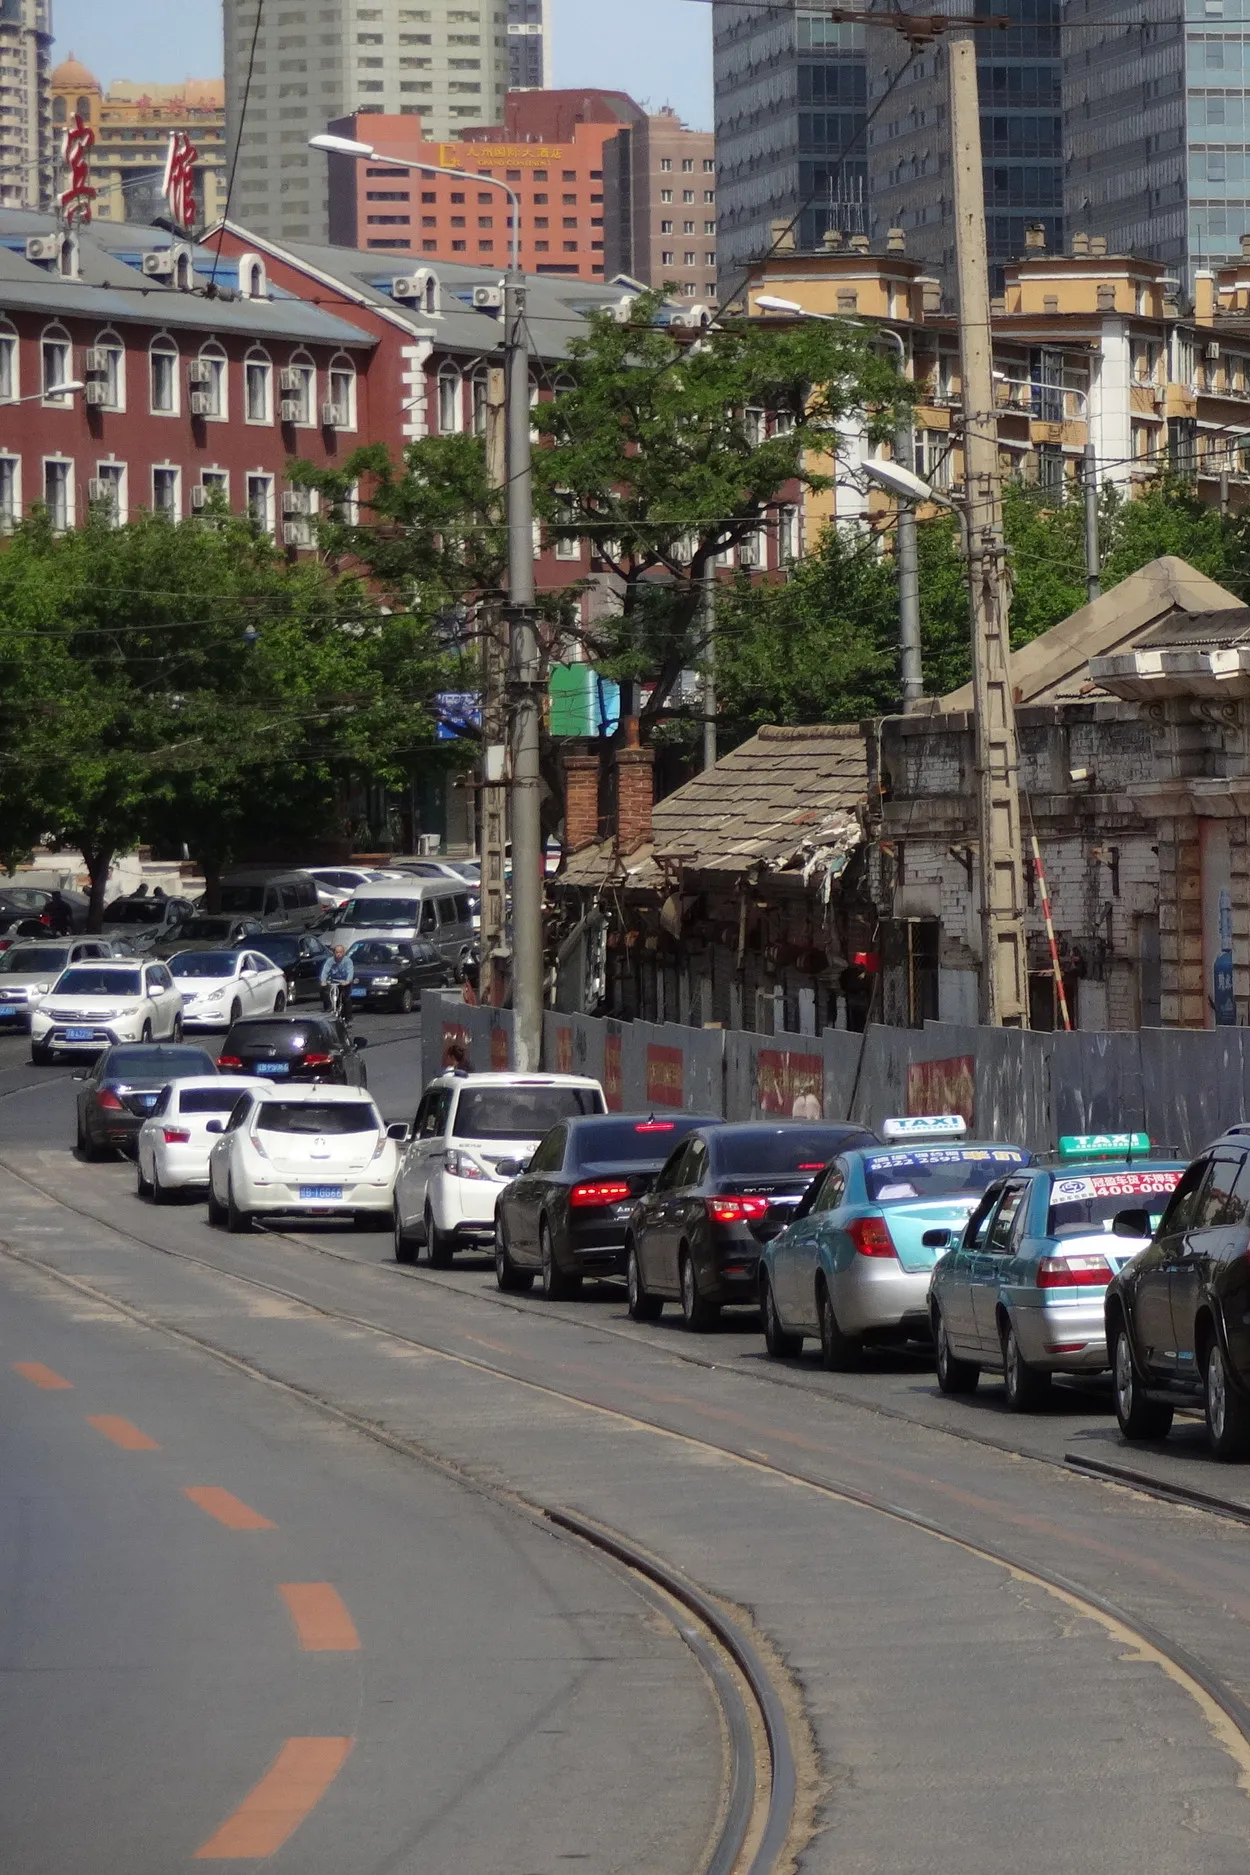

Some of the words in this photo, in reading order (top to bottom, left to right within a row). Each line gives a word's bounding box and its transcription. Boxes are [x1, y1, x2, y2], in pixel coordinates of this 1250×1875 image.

[466, 145, 563, 158] 九州国际大酒店
[893, 1117, 959, 1128] TAXI
[1073, 1132, 1140, 1147] TAXI
